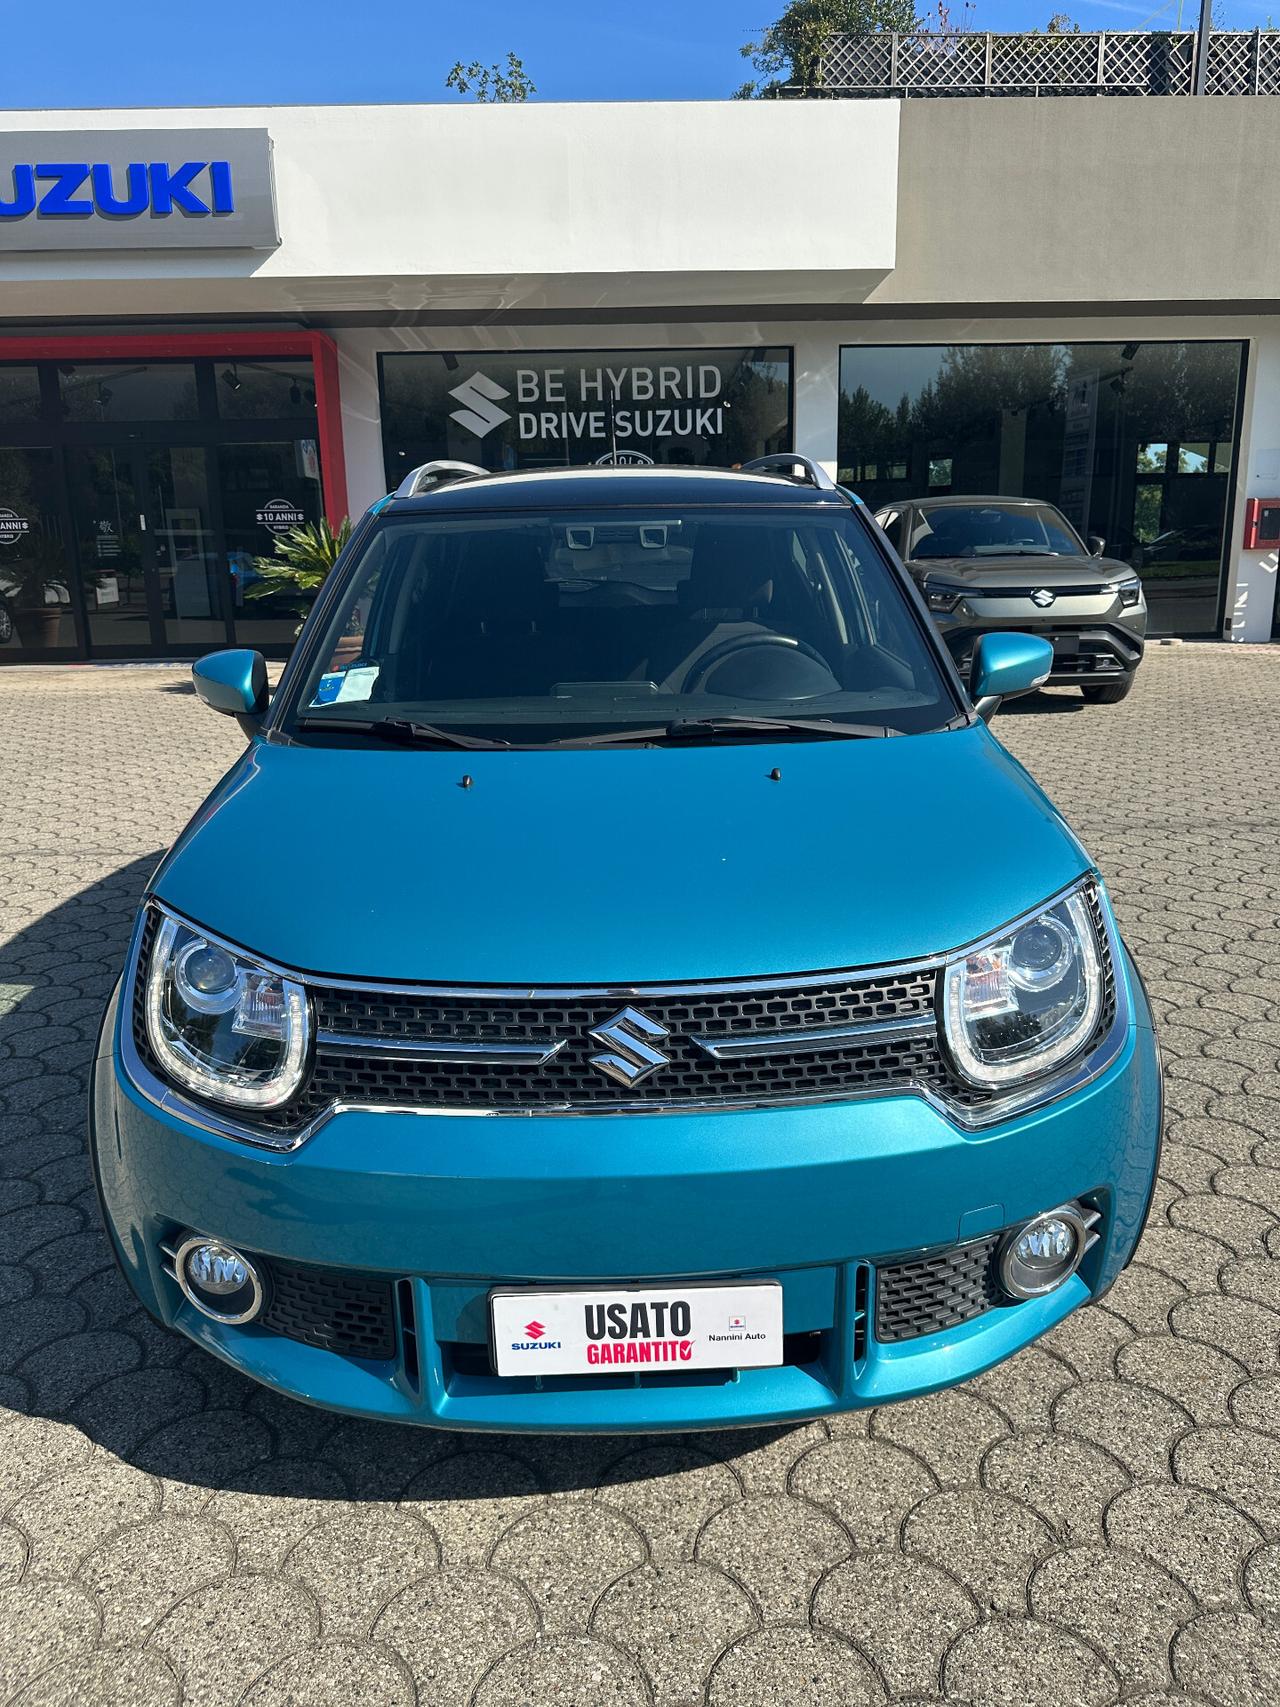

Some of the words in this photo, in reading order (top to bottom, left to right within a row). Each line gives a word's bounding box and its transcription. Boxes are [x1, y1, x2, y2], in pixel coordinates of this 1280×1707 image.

[516, 369, 565, 403] BE
[580, 365, 722, 401] HYBRID
[519, 411, 606, 439] DRIVE
[614, 408, 723, 437] SUZUKI
[263, 512, 274, 521] 10
[275, 512, 297, 521] ANNI
[0, 521, 22, 530] ANNI
[584, 1301, 692, 1340] USATO
[511, 1341, 562, 1350] SUZUKI
[708, 1333, 743, 1342] Nannini
[586, 1339, 696, 1365] GARANTITO
